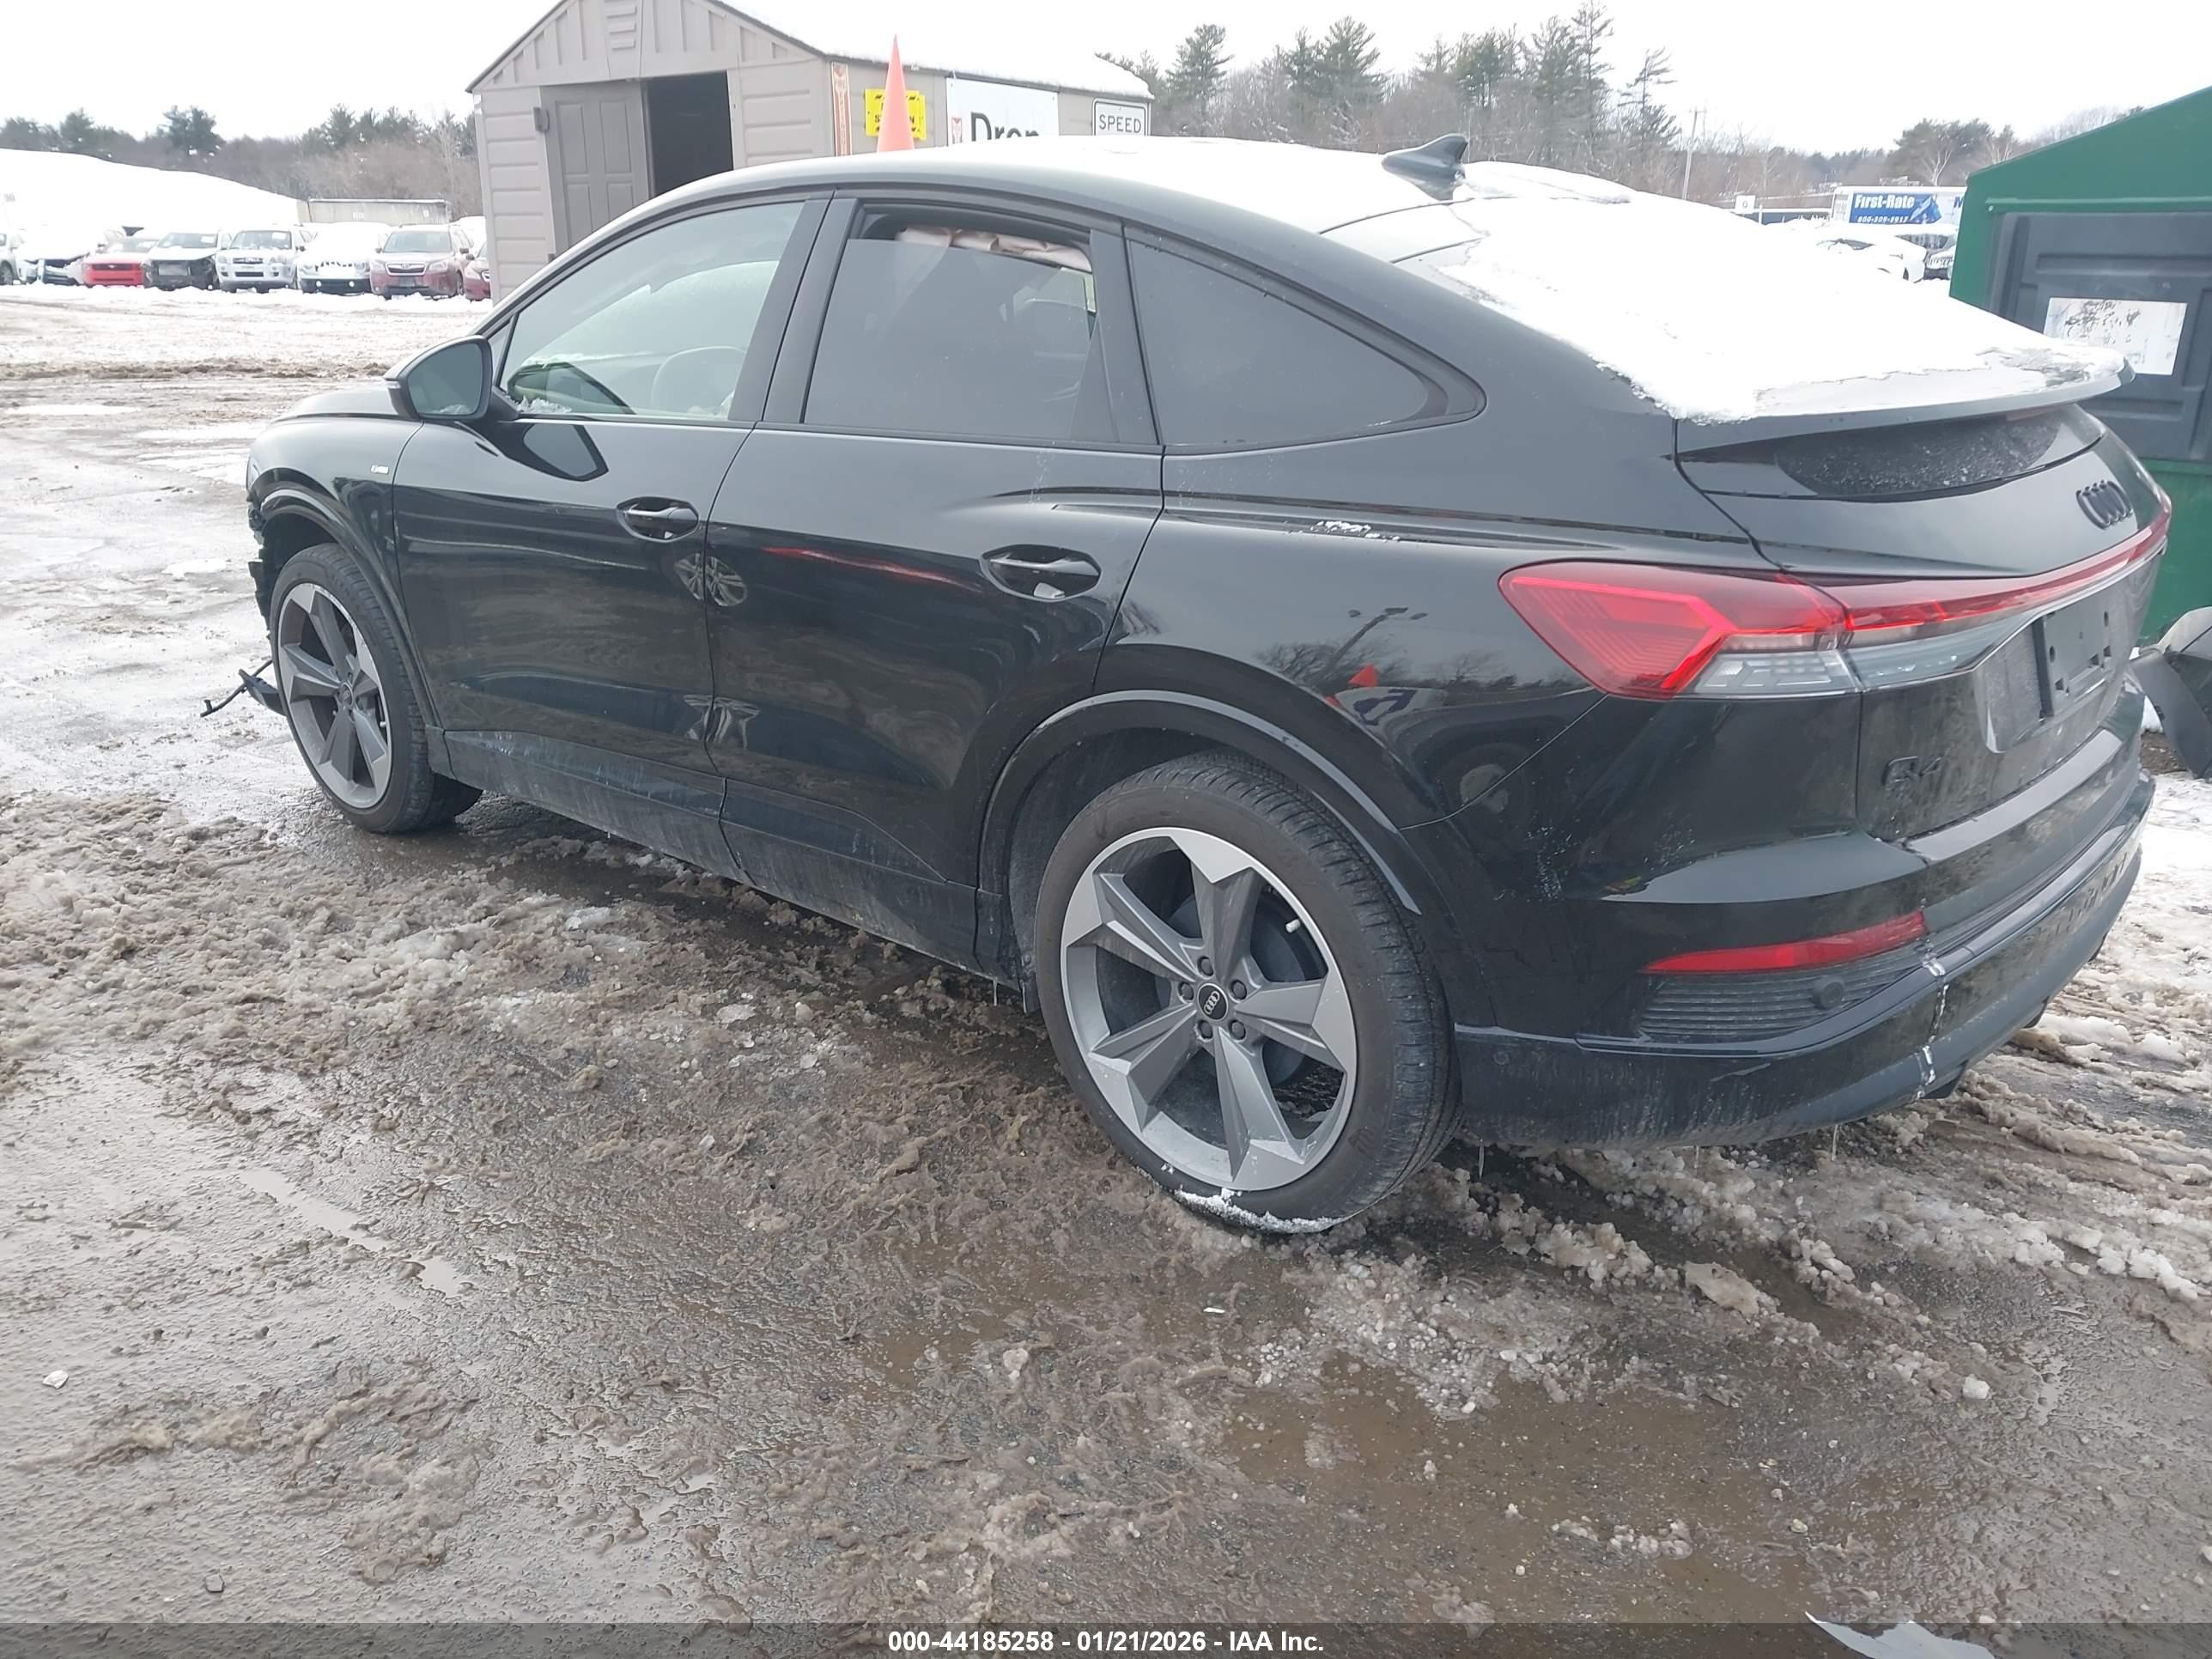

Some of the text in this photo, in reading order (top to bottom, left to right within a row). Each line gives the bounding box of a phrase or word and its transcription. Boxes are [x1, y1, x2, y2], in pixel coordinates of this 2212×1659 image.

[970, 112, 1040, 142] Dro
[1099, 113, 1142, 133] SPEED
[1855, 194, 1916, 209] First-Rate
